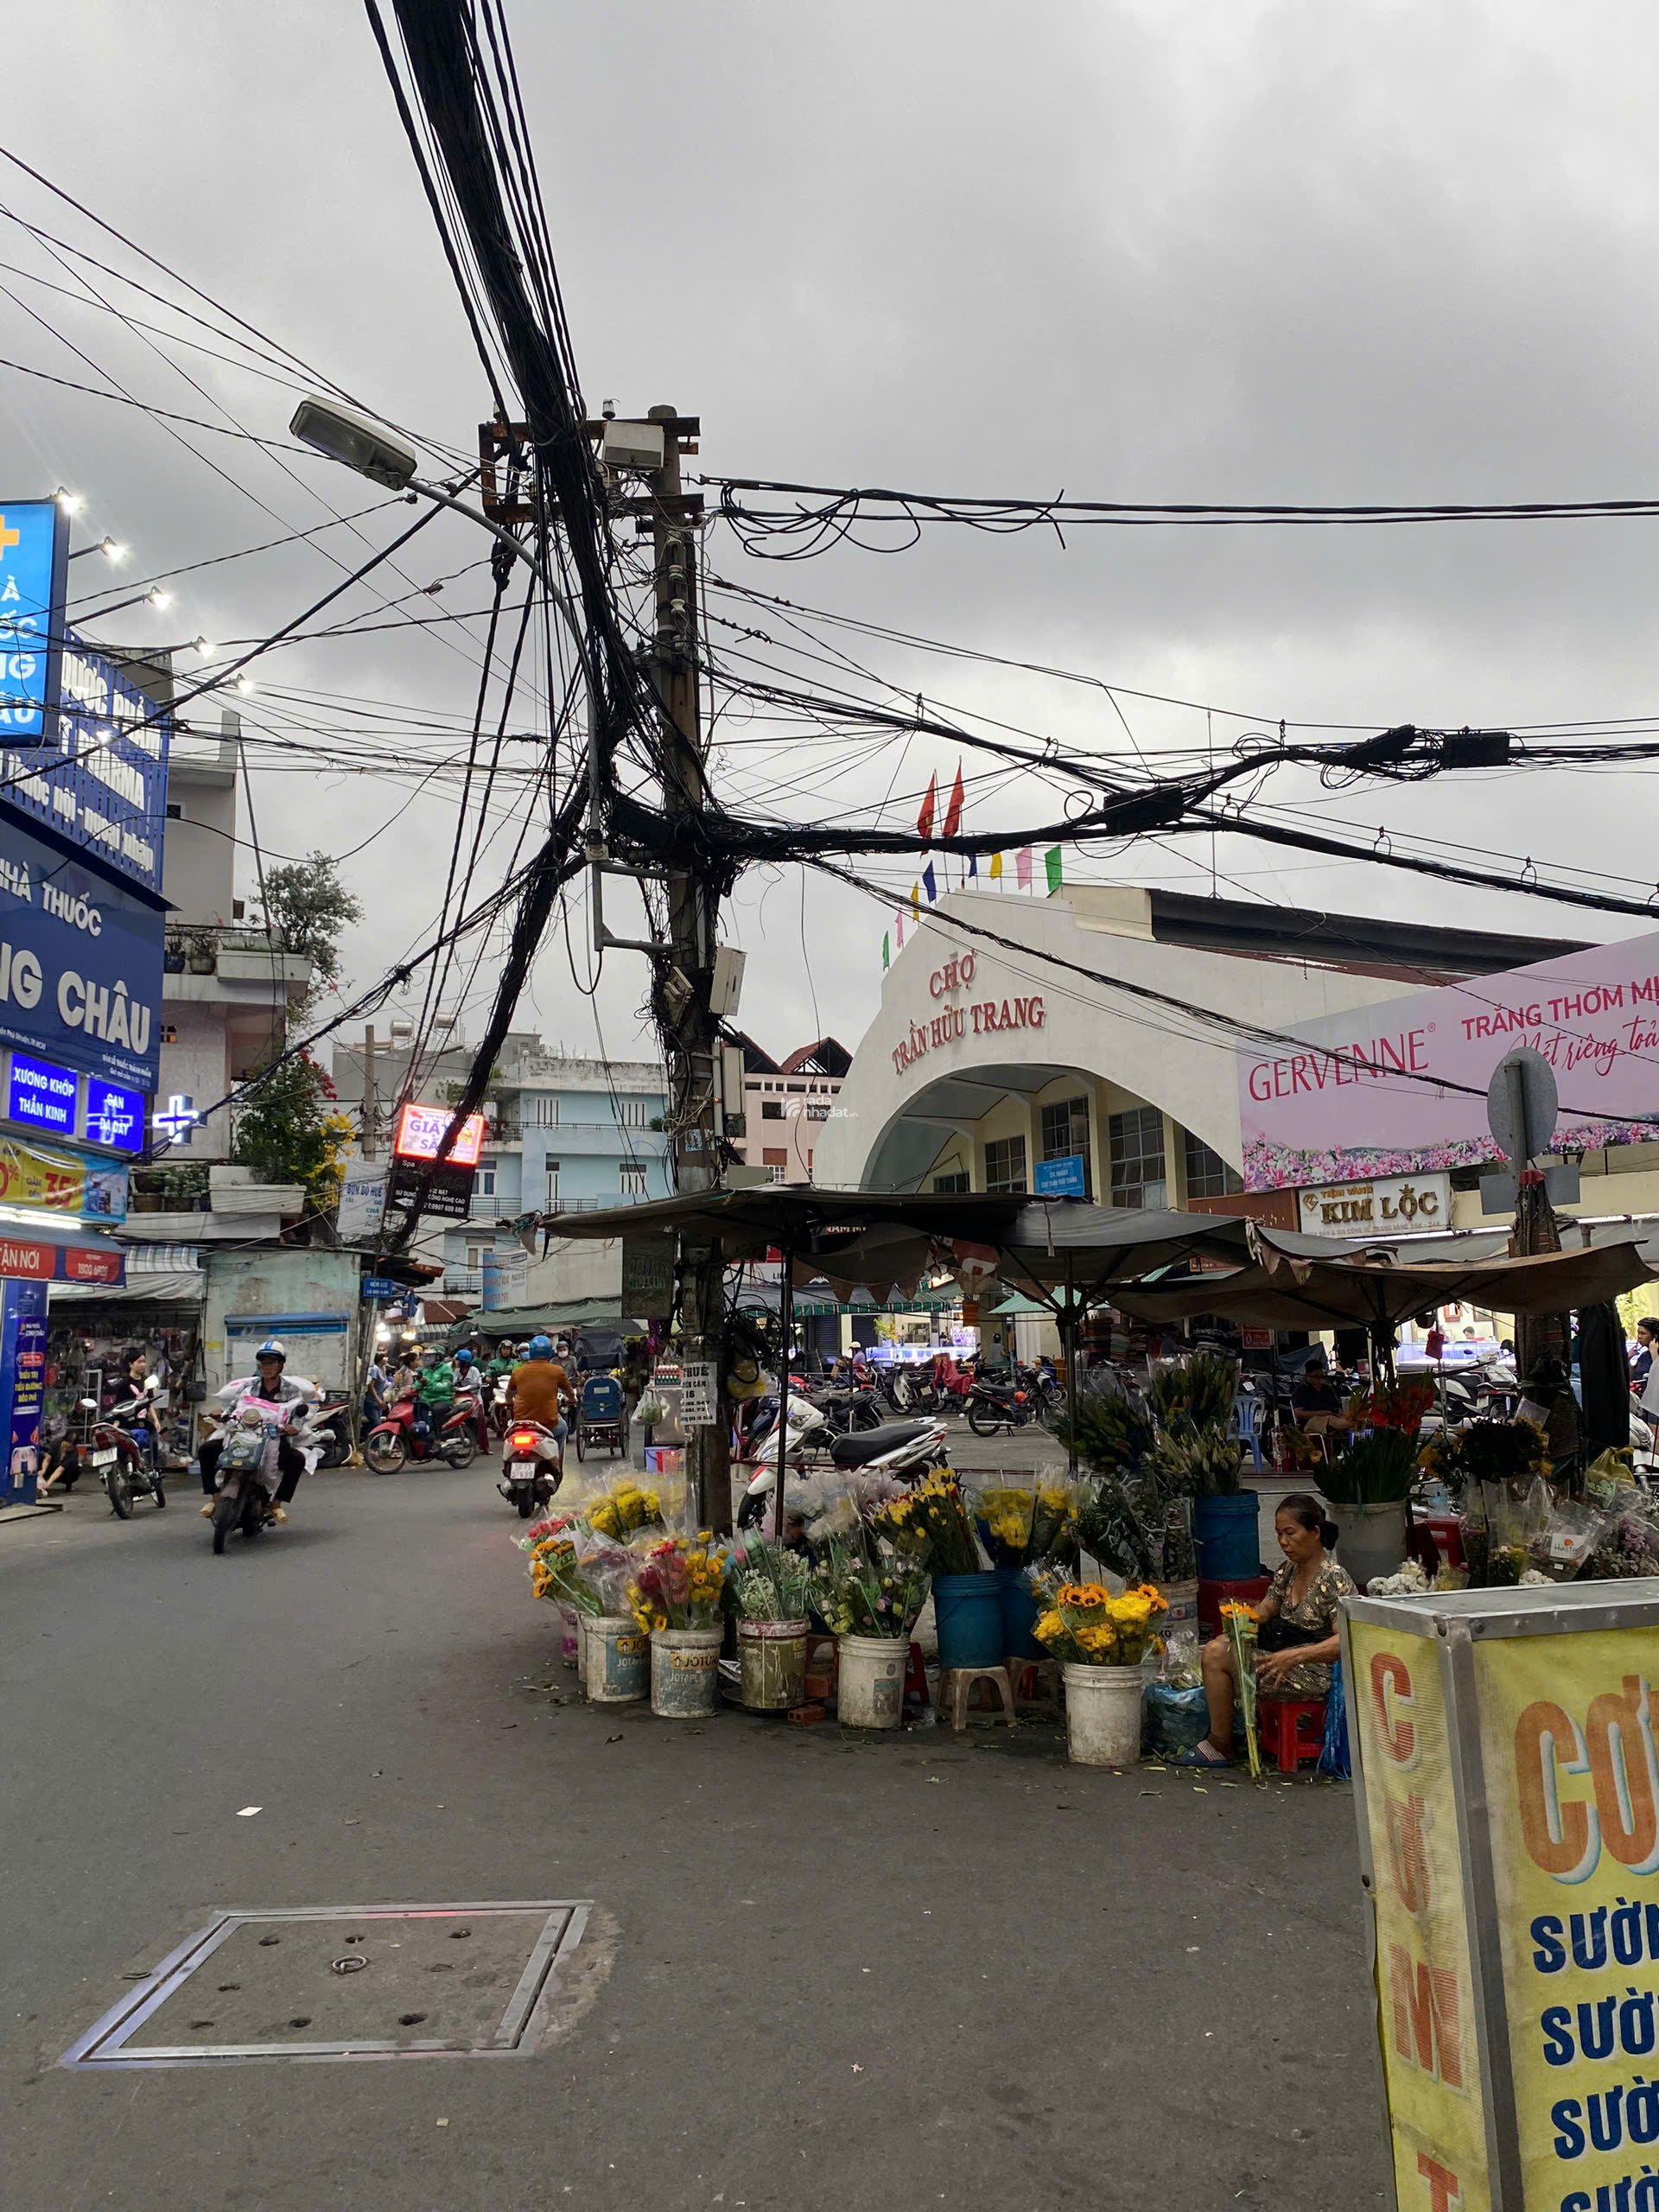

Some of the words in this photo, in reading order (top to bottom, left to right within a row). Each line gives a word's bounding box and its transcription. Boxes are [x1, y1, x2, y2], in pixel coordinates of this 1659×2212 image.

[0, 653, 36, 680] G
[41, 880, 102, 937] THUỐC
[929, 950, 976, 999] CHỢ
[57, 970, 151, 1055] CHÂU
[892, 1020, 928, 1076] TRẦN
[969, 996, 1045, 1034] TRANG
[1461, 1003, 1542, 1040] TRẮNG
[1548, 984, 1624, 1021] THƠM
[14, 1066, 48, 1090] XƯƠNG
[50, 1076, 74, 1097] KHỚP
[1249, 1029, 1428, 1102] GERVENNE
[19, 1094, 43, 1116] THẦN
[46, 1102, 67, 1123] KINH
[402, 1160, 415, 1168] Spa
[1319, 1198, 1374, 1224] KIM
[1379, 1184, 1440, 1222] LỘC
[0, 1243, 18, 1273] ẬN
[20, 1249, 40, 1270] NƠI
[1515, 1675, 1659, 1877] CƠ
[1541, 1987, 1659, 2066] SƯỜ
